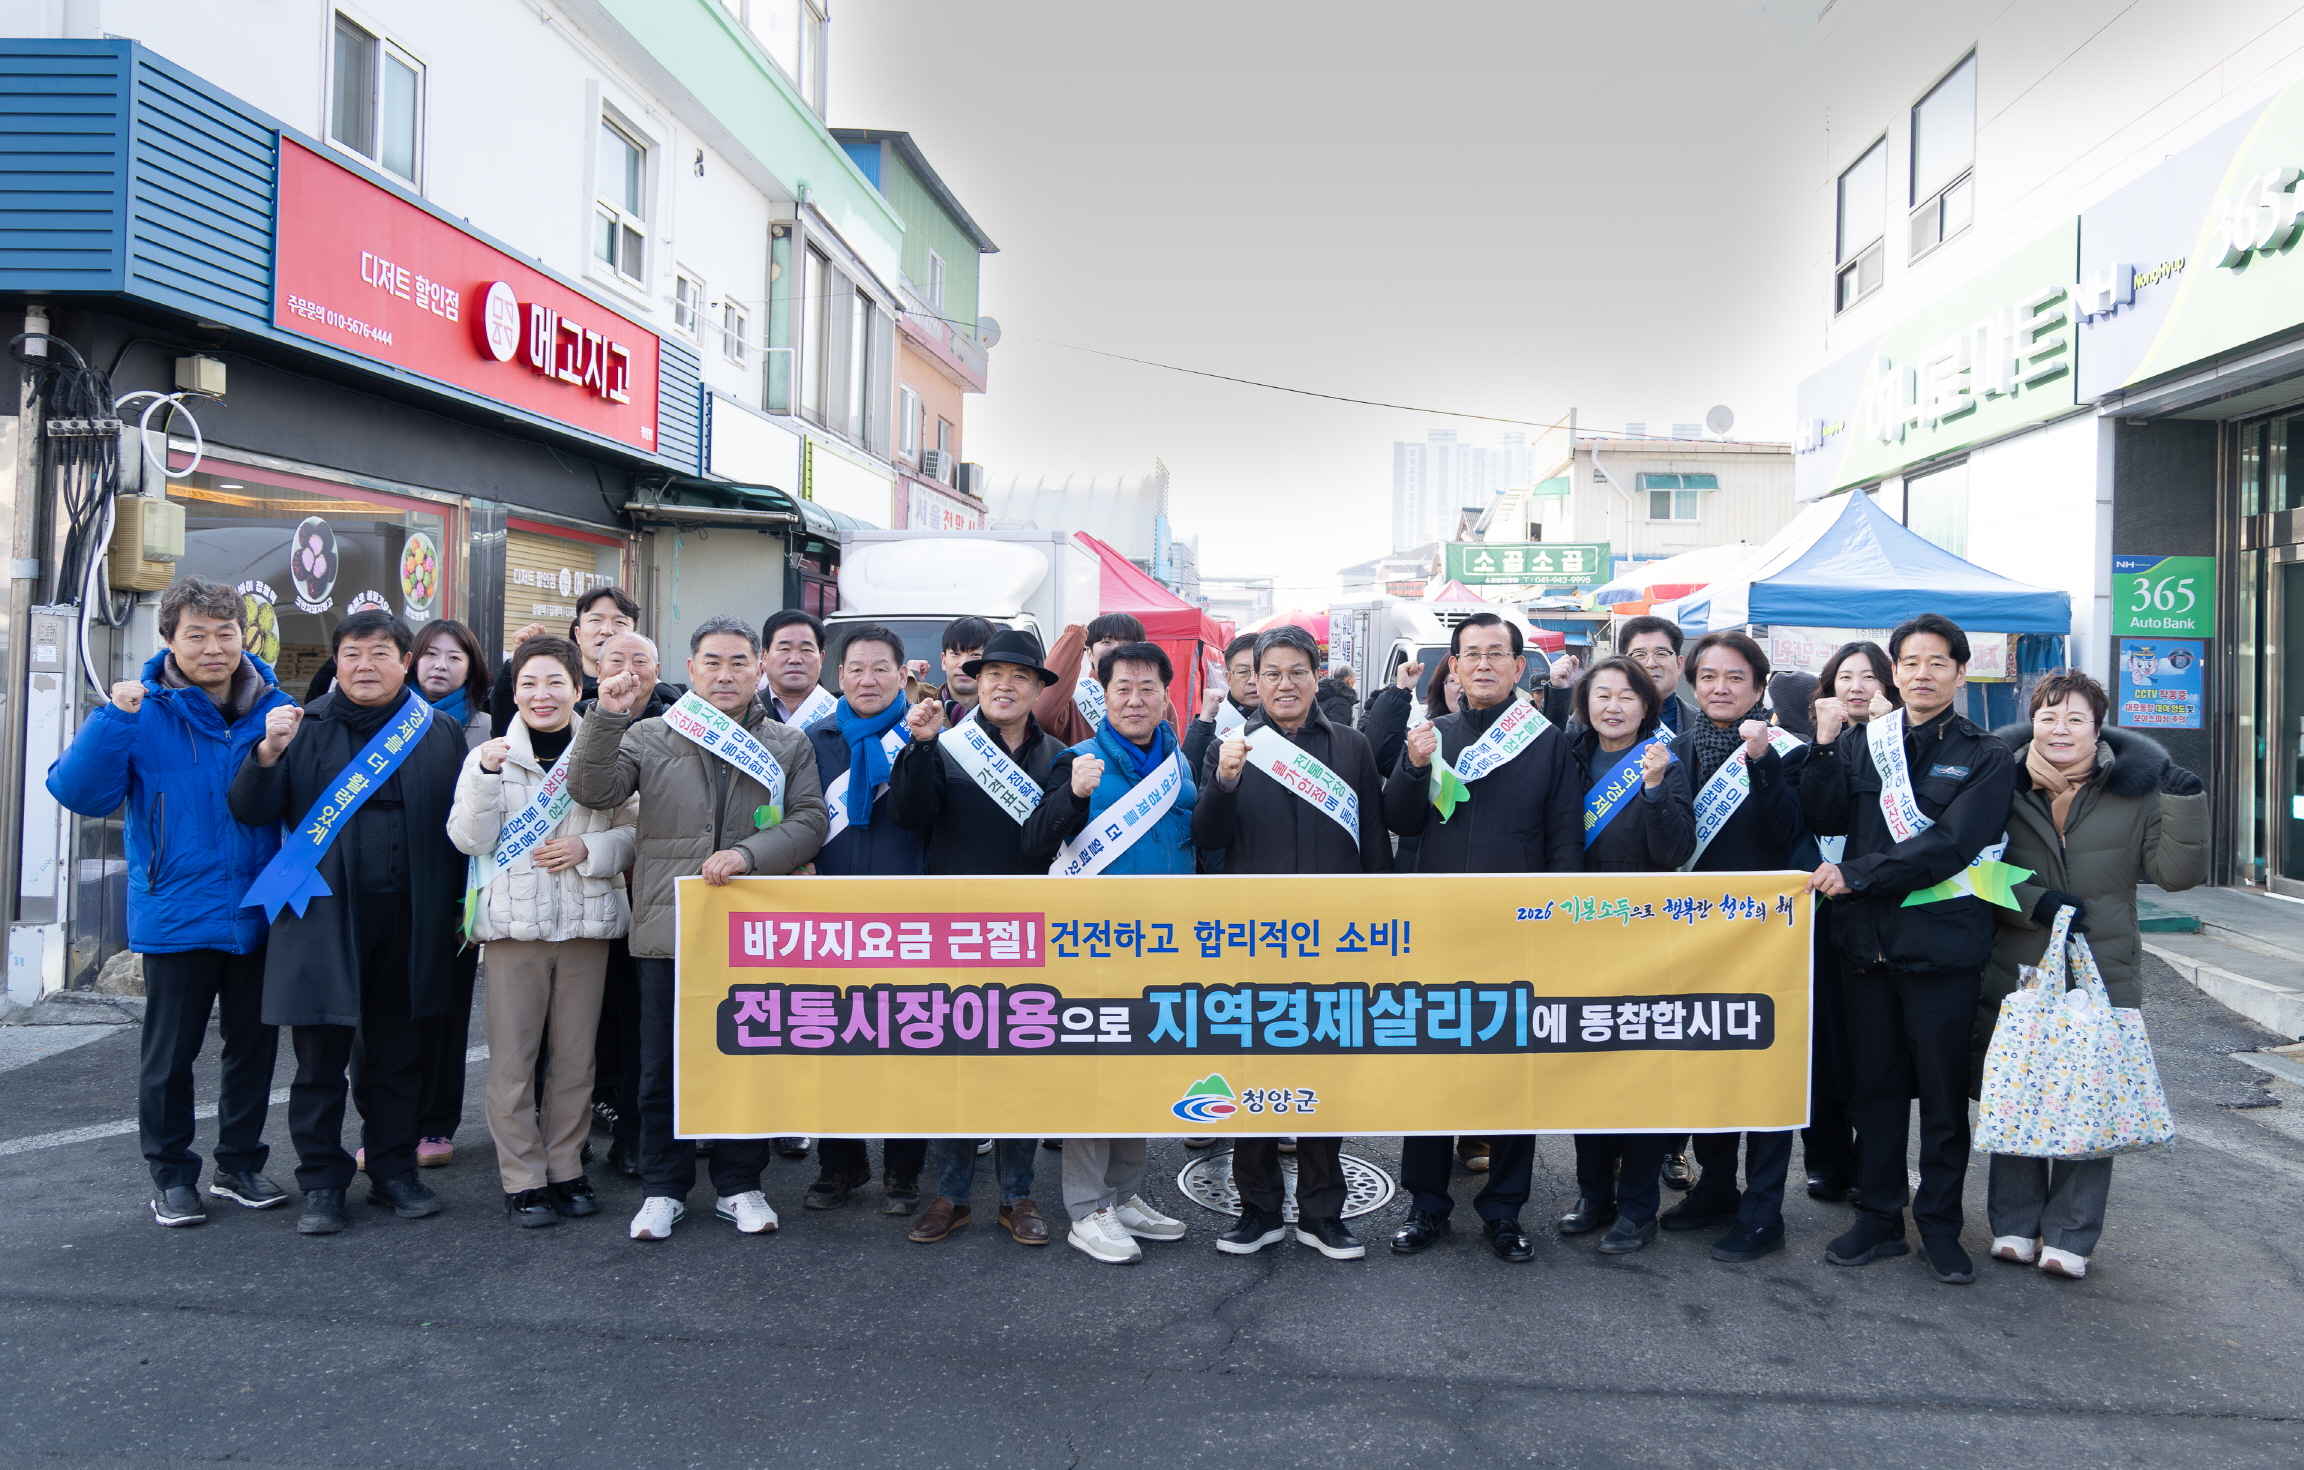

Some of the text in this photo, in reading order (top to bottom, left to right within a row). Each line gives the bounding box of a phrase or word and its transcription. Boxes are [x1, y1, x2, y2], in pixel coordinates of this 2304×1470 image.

[360, 251, 460, 323] 디저트 할인점
[2069, 256, 2186, 325] NH NongHyup
[287, 294, 393, 347] 주문문의 010-5676-4444
[529, 303, 631, 405] 메고지고
[1865, 286, 2067, 441] 하나로마트
[513, 568, 536, 587] 디저트
[536, 570, 557, 590] 할인점
[1473, 550, 1585, 573] 소곱소곱
[1535, 576, 1592, 584] 041-942-9995
[2115, 560, 2135, 569] NH
[232, 580, 254, 596] 바이
[2130, 576, 2196, 614] 365
[2129, 616, 2196, 630] Auto Bank
[2125, 703, 2154, 713] 대포통장
[2187, 704, 2195, 714] 및
[2134, 689, 2187, 701] CCTV 작동중
[680, 694, 781, 776] 전통시장 이용하여
[1502, 713, 1547, 754] 전통시장
[2133, 713, 2187, 724] 보이스피싱 주의
[366, 752, 390, 775] 더
[667, 707, 779, 799] 물가안정에 동참합시다
[963, 727, 1010, 773] 판매자는
[1889, 747, 1907, 787] 정확히
[976, 767, 1030, 818] 가격표시
[1271, 760, 1340, 812] 물가안정에
[1293, 753, 1346, 798] 전통시장
[1871, 739, 1913, 842] 가격표시 원산지
[306, 772, 370, 846] 활력있게
[1064, 768, 1179, 875] 지역경제를 더 활력있
[1696, 788, 1742, 843] 이용하여
[496, 819, 550, 867] 이용하여
[1516, 893, 1795, 927] 2026 기본소득으로 행복한 청양의 해
[743, 918, 1411, 961] 바가지요금 근절! 건전하고 합리적인 소비!
[732, 987, 1761, 1049] 전통시장이용으로 지역경제살리기에 동참합시다
[1241, 1088, 1319, 1114] 청양군
